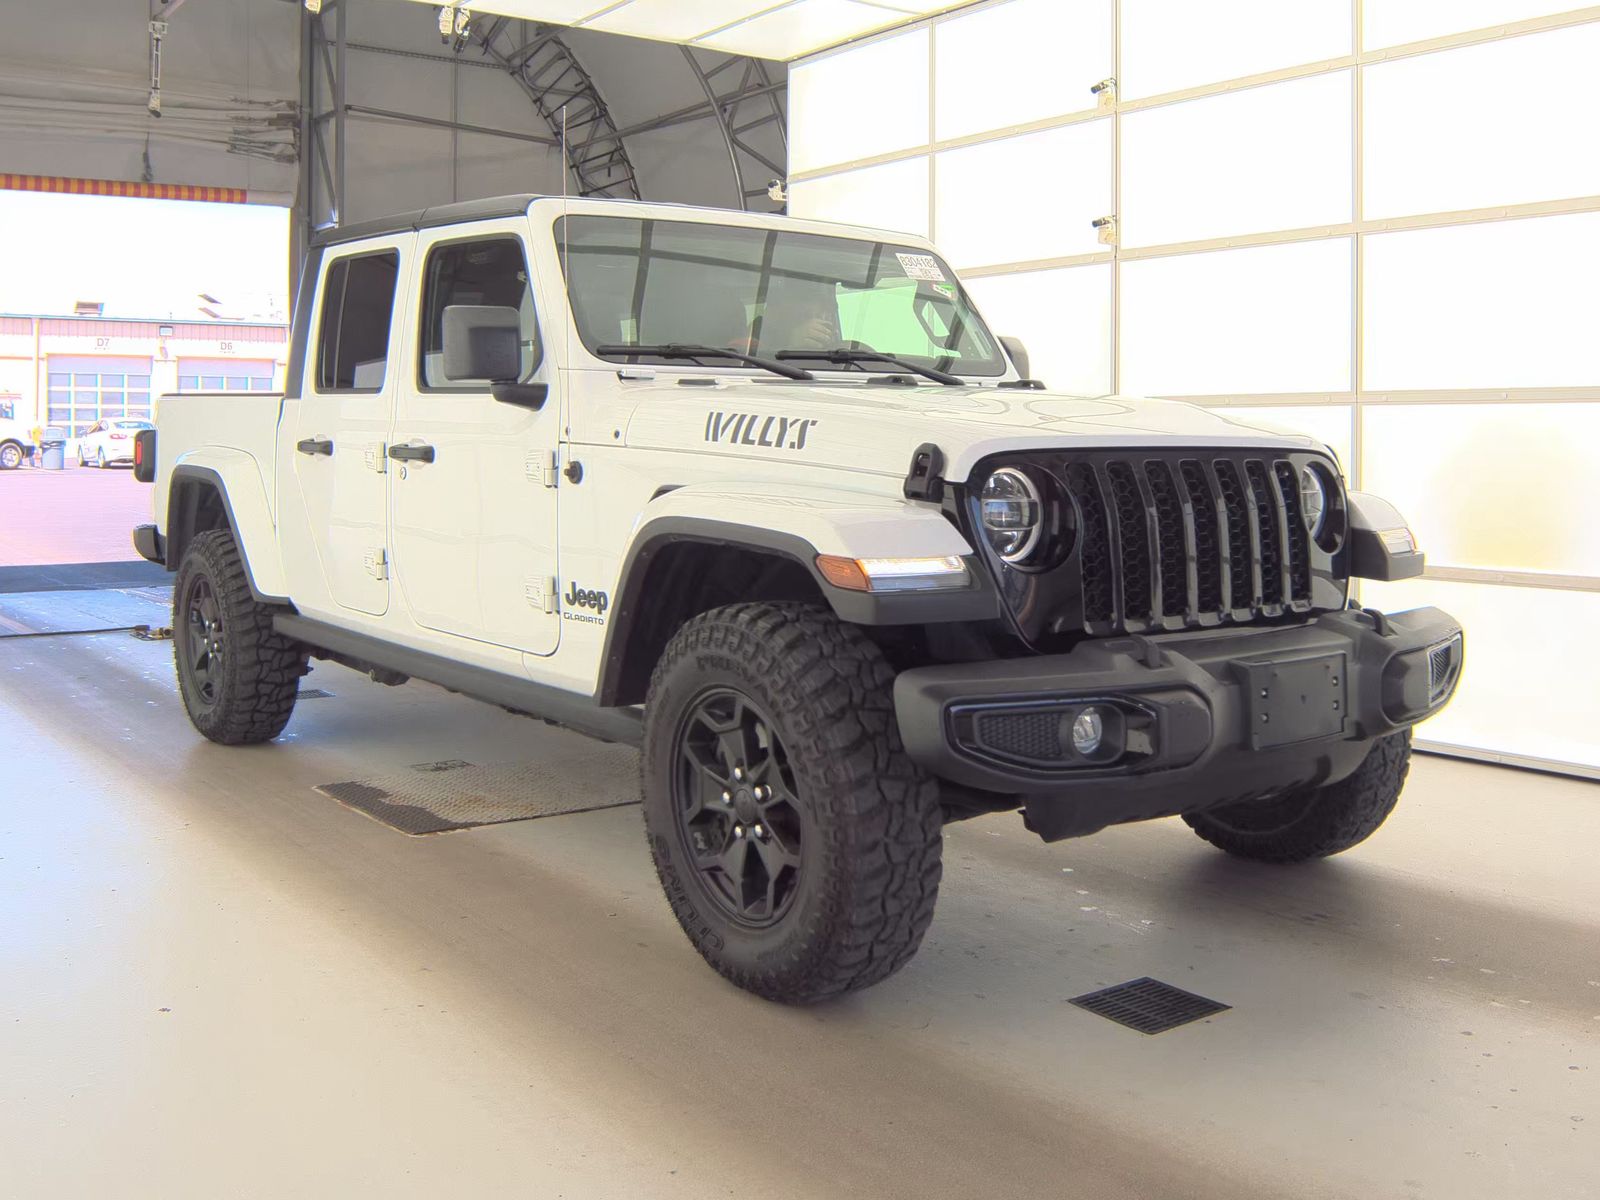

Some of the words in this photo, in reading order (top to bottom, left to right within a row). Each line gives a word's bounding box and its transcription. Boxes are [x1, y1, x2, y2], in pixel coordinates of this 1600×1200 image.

[96, 338, 110, 347] D7
[704, 411, 818, 450] WILLYS
[565, 581, 608, 615] Jeep
